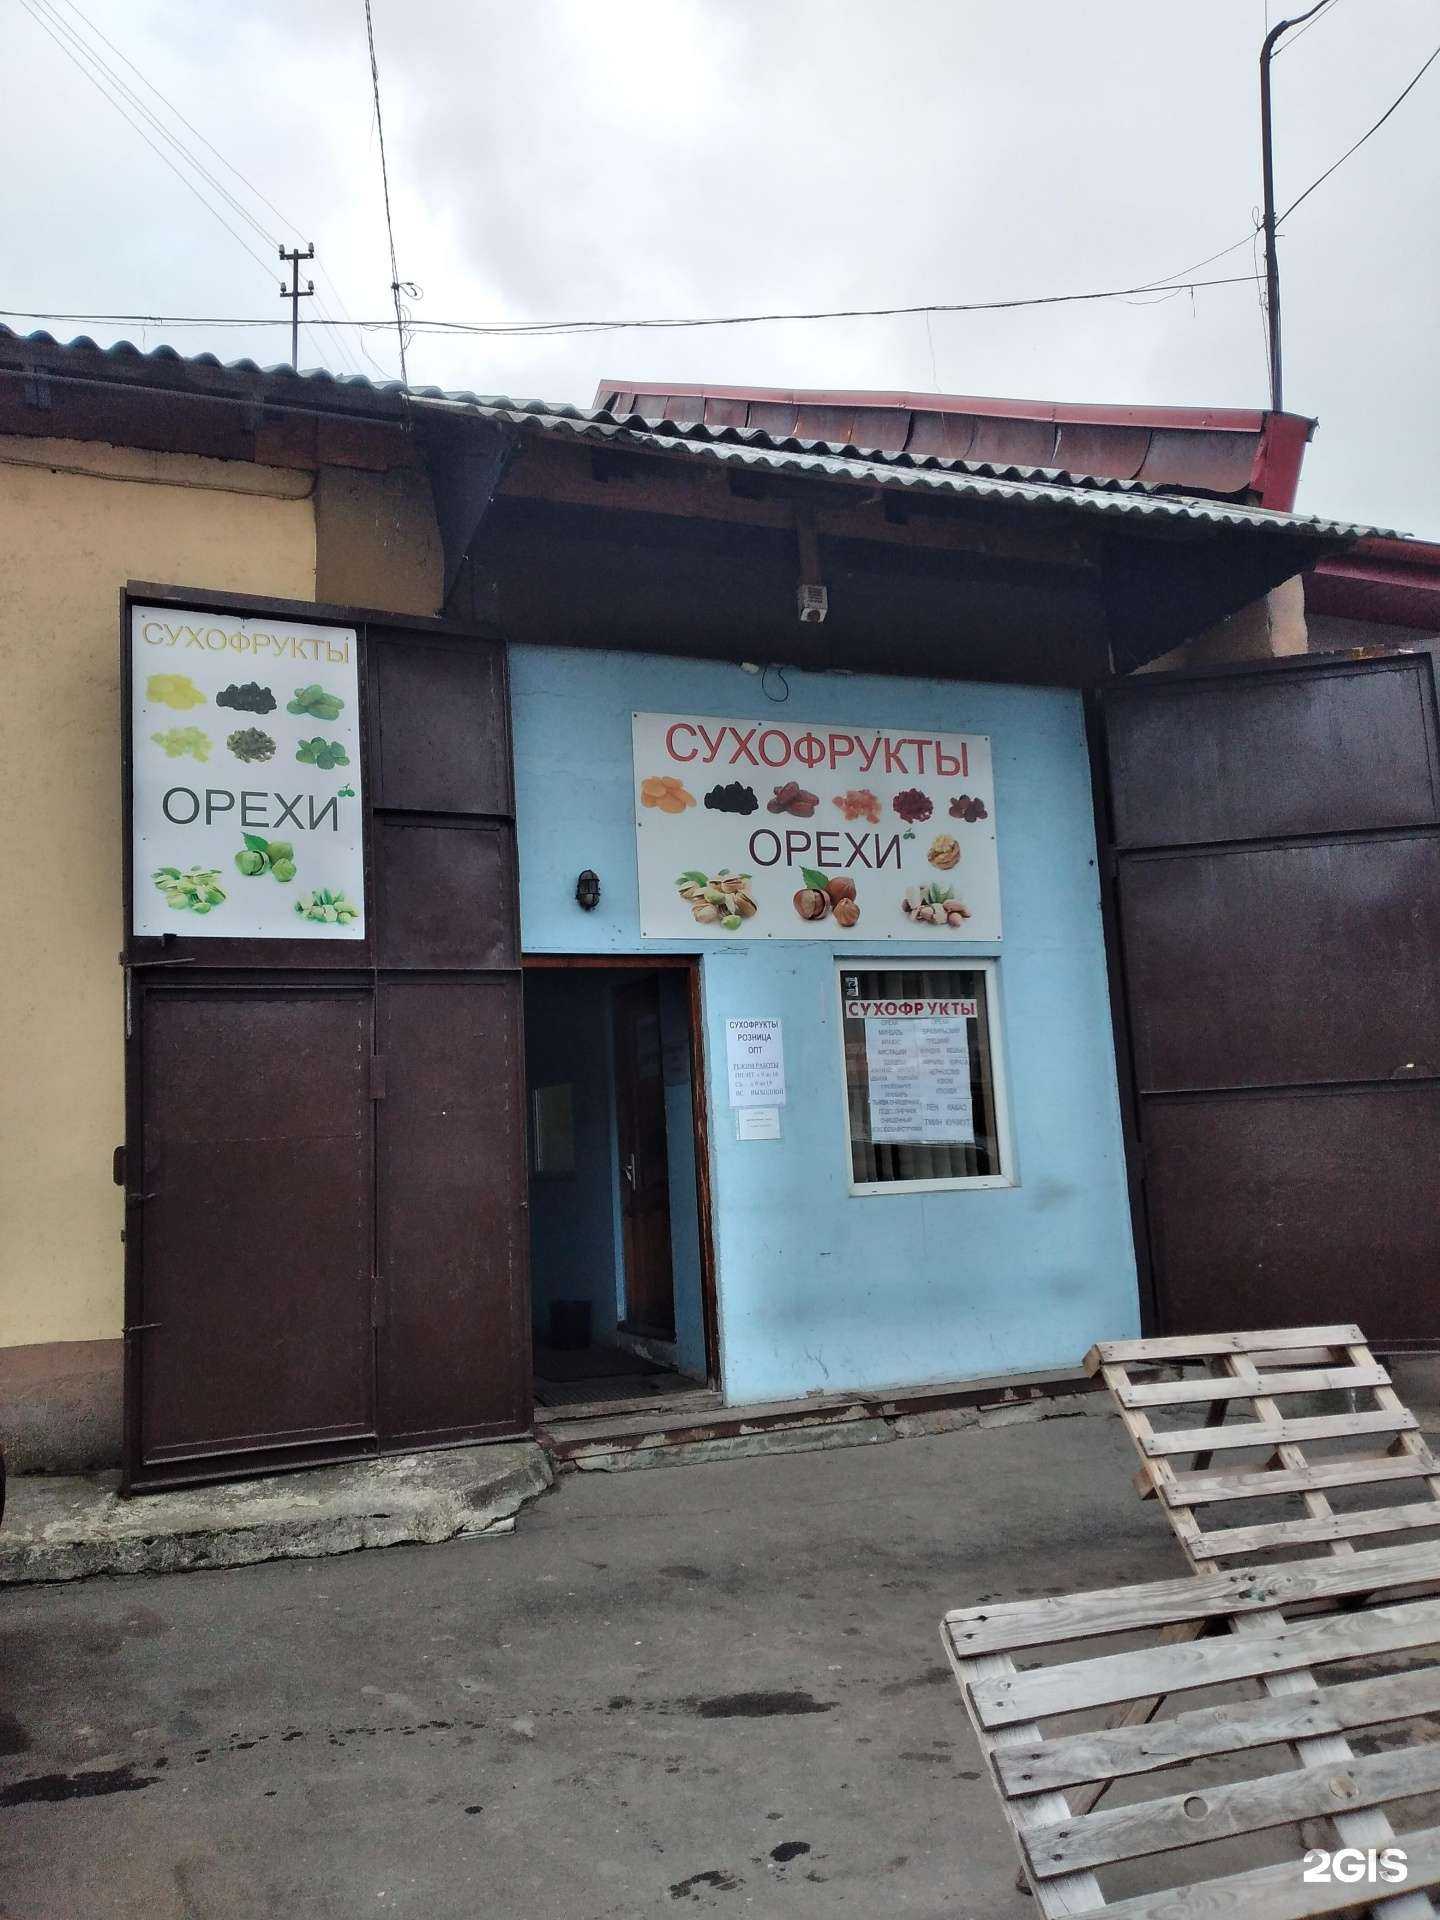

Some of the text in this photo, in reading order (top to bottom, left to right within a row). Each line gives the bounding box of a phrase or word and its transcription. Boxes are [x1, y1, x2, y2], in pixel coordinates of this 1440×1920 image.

[142, 621, 350, 666] СУХОФРУКТЫ
[665, 722, 970, 778] СУХОФРУКТЫ
[162, 786, 339, 832] ОРЕХИ
[748, 828, 902, 870] ОРЕХИ
[848, 1001, 976, 1017] СУХОФРУКТЫ
[729, 1020, 779, 1029] СУХОФРУКТЫ
[737, 1033, 772, 1043] РОЗНИЦА
[748, 1046, 763, 1055] ОПТ
